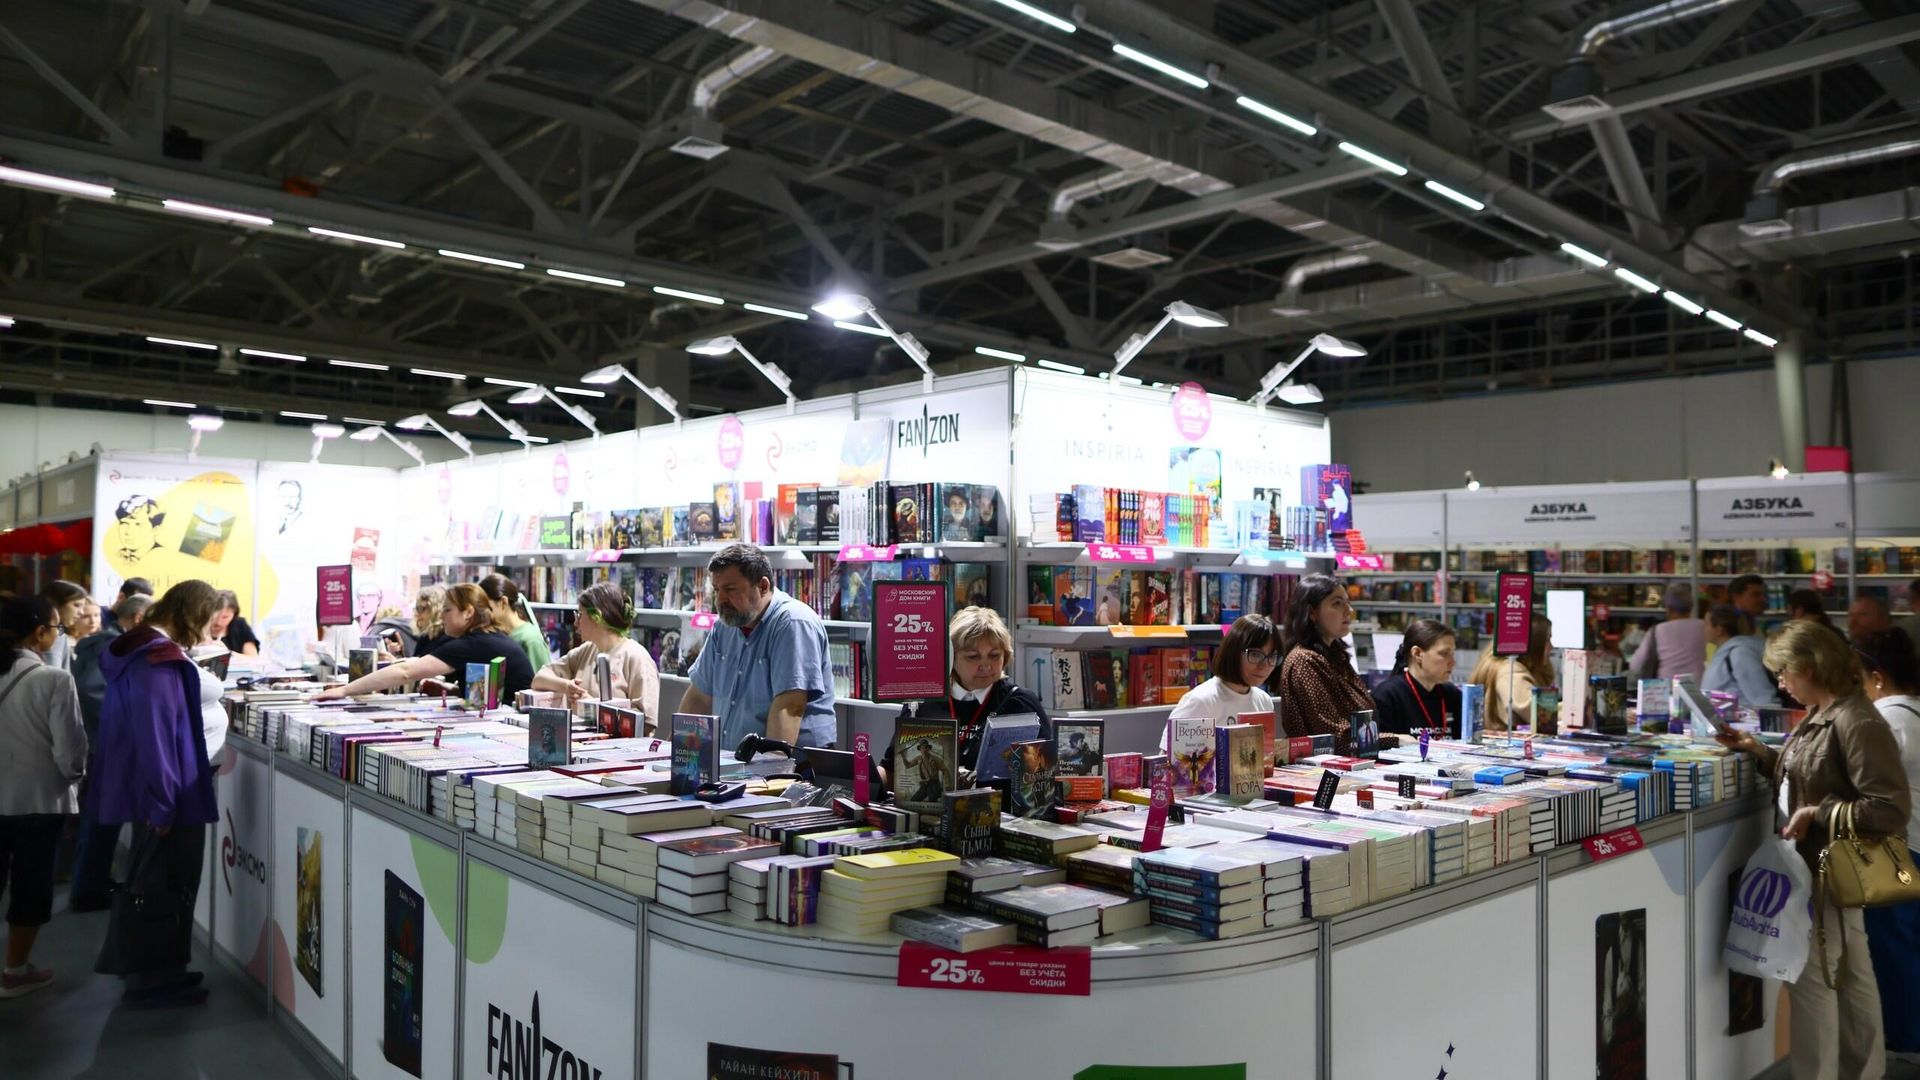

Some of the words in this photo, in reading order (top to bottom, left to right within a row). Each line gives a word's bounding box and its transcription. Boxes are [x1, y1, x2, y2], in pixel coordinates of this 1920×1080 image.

[898, 404, 960, 458] FANZON
[1065, 440, 1144, 462] INSPIRIA
[1229, 458, 1292, 477] INSPIRIA
[1530, 502, 1587, 515] АЗБУКА
[1731, 497, 1803, 510] АЗБУКА
[1503, 594, 1526, 609] -25%
[887, 613, 934, 634] -25%
[1178, 726, 1213, 739] Вербер
[1236, 780, 1261, 795] ГОРА
[237, 845, 266, 884] ЭКСМО
[921, 957, 985, 984] -25%
[1020, 968, 1036, 976] БЕЗ
[1038, 967, 1066, 977] УЧЁТА
[1029, 978, 1066, 987] СКИДКИ
[720, 1058, 756, 1076] РАЙАН
